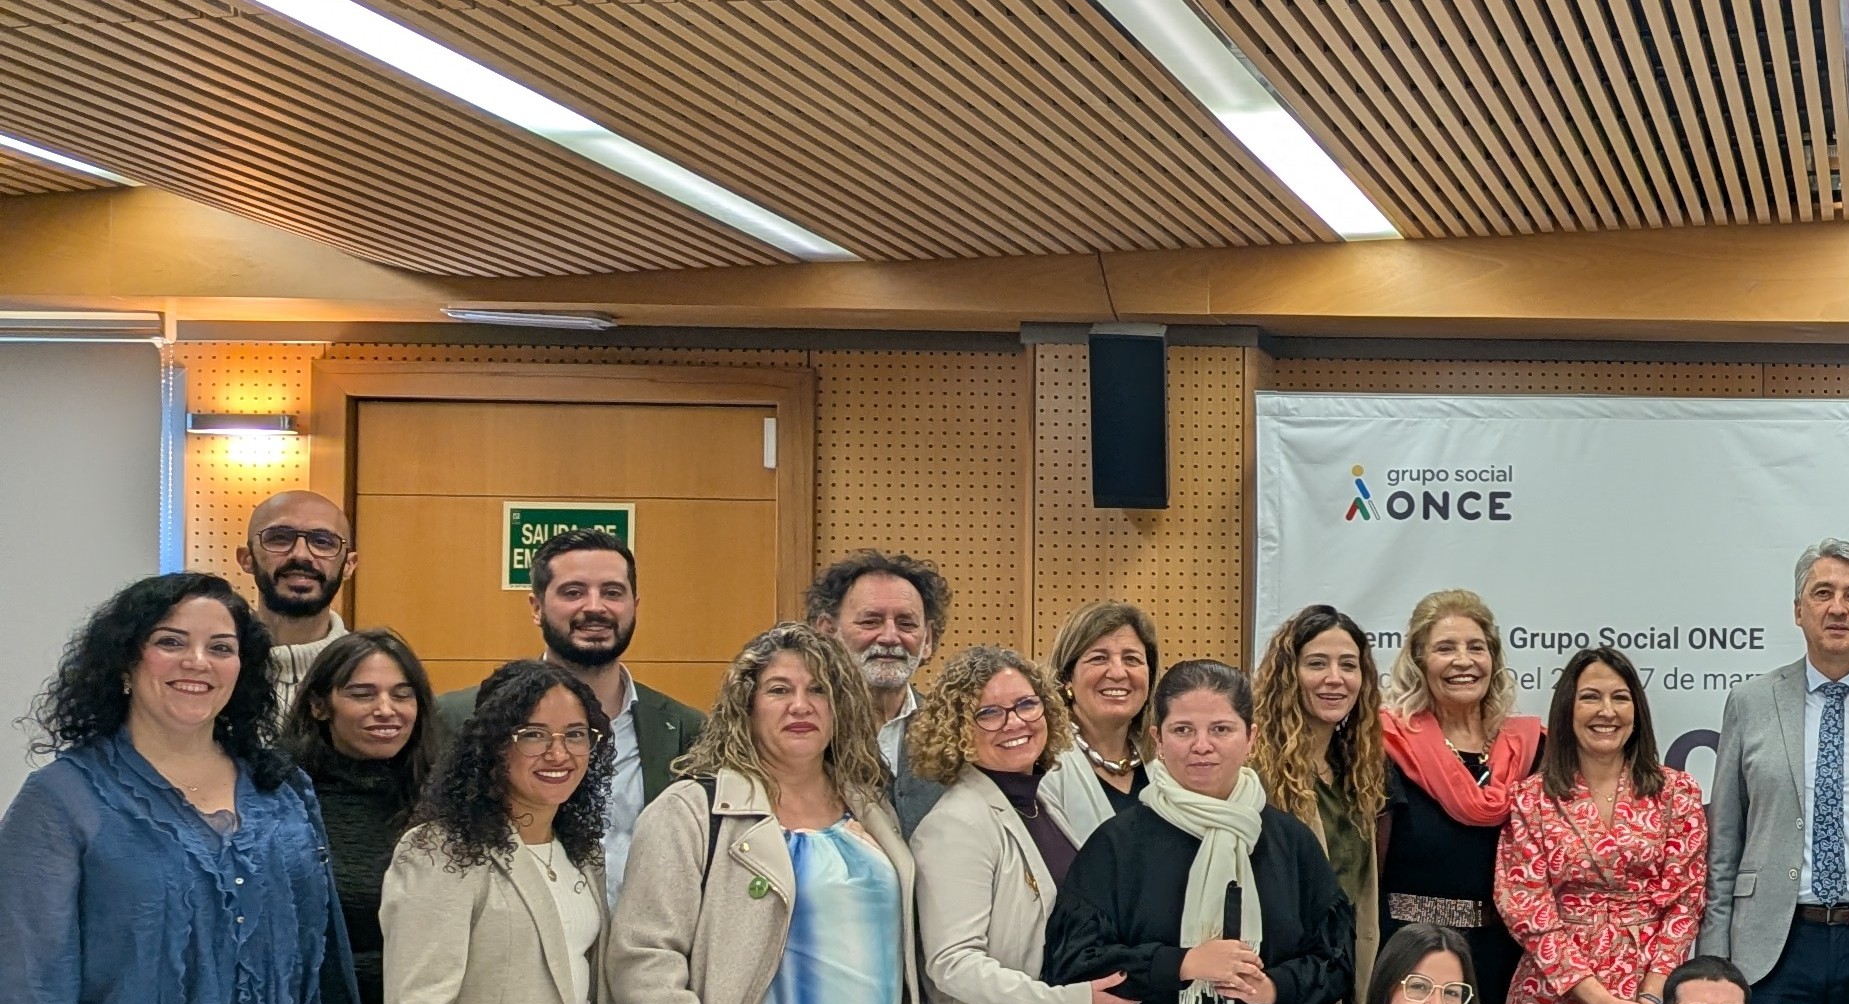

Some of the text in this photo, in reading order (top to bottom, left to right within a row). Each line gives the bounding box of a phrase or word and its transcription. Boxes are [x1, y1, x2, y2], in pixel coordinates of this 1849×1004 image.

[1387, 465, 1513, 486] grupo social
[1386, 490, 1512, 521] ONCE
[1509, 626, 1590, 655] Grupo
[1599, 626, 1679, 650] Social
[1688, 627, 1765, 650] ONCE
[1663, 666, 1695, 690] de
